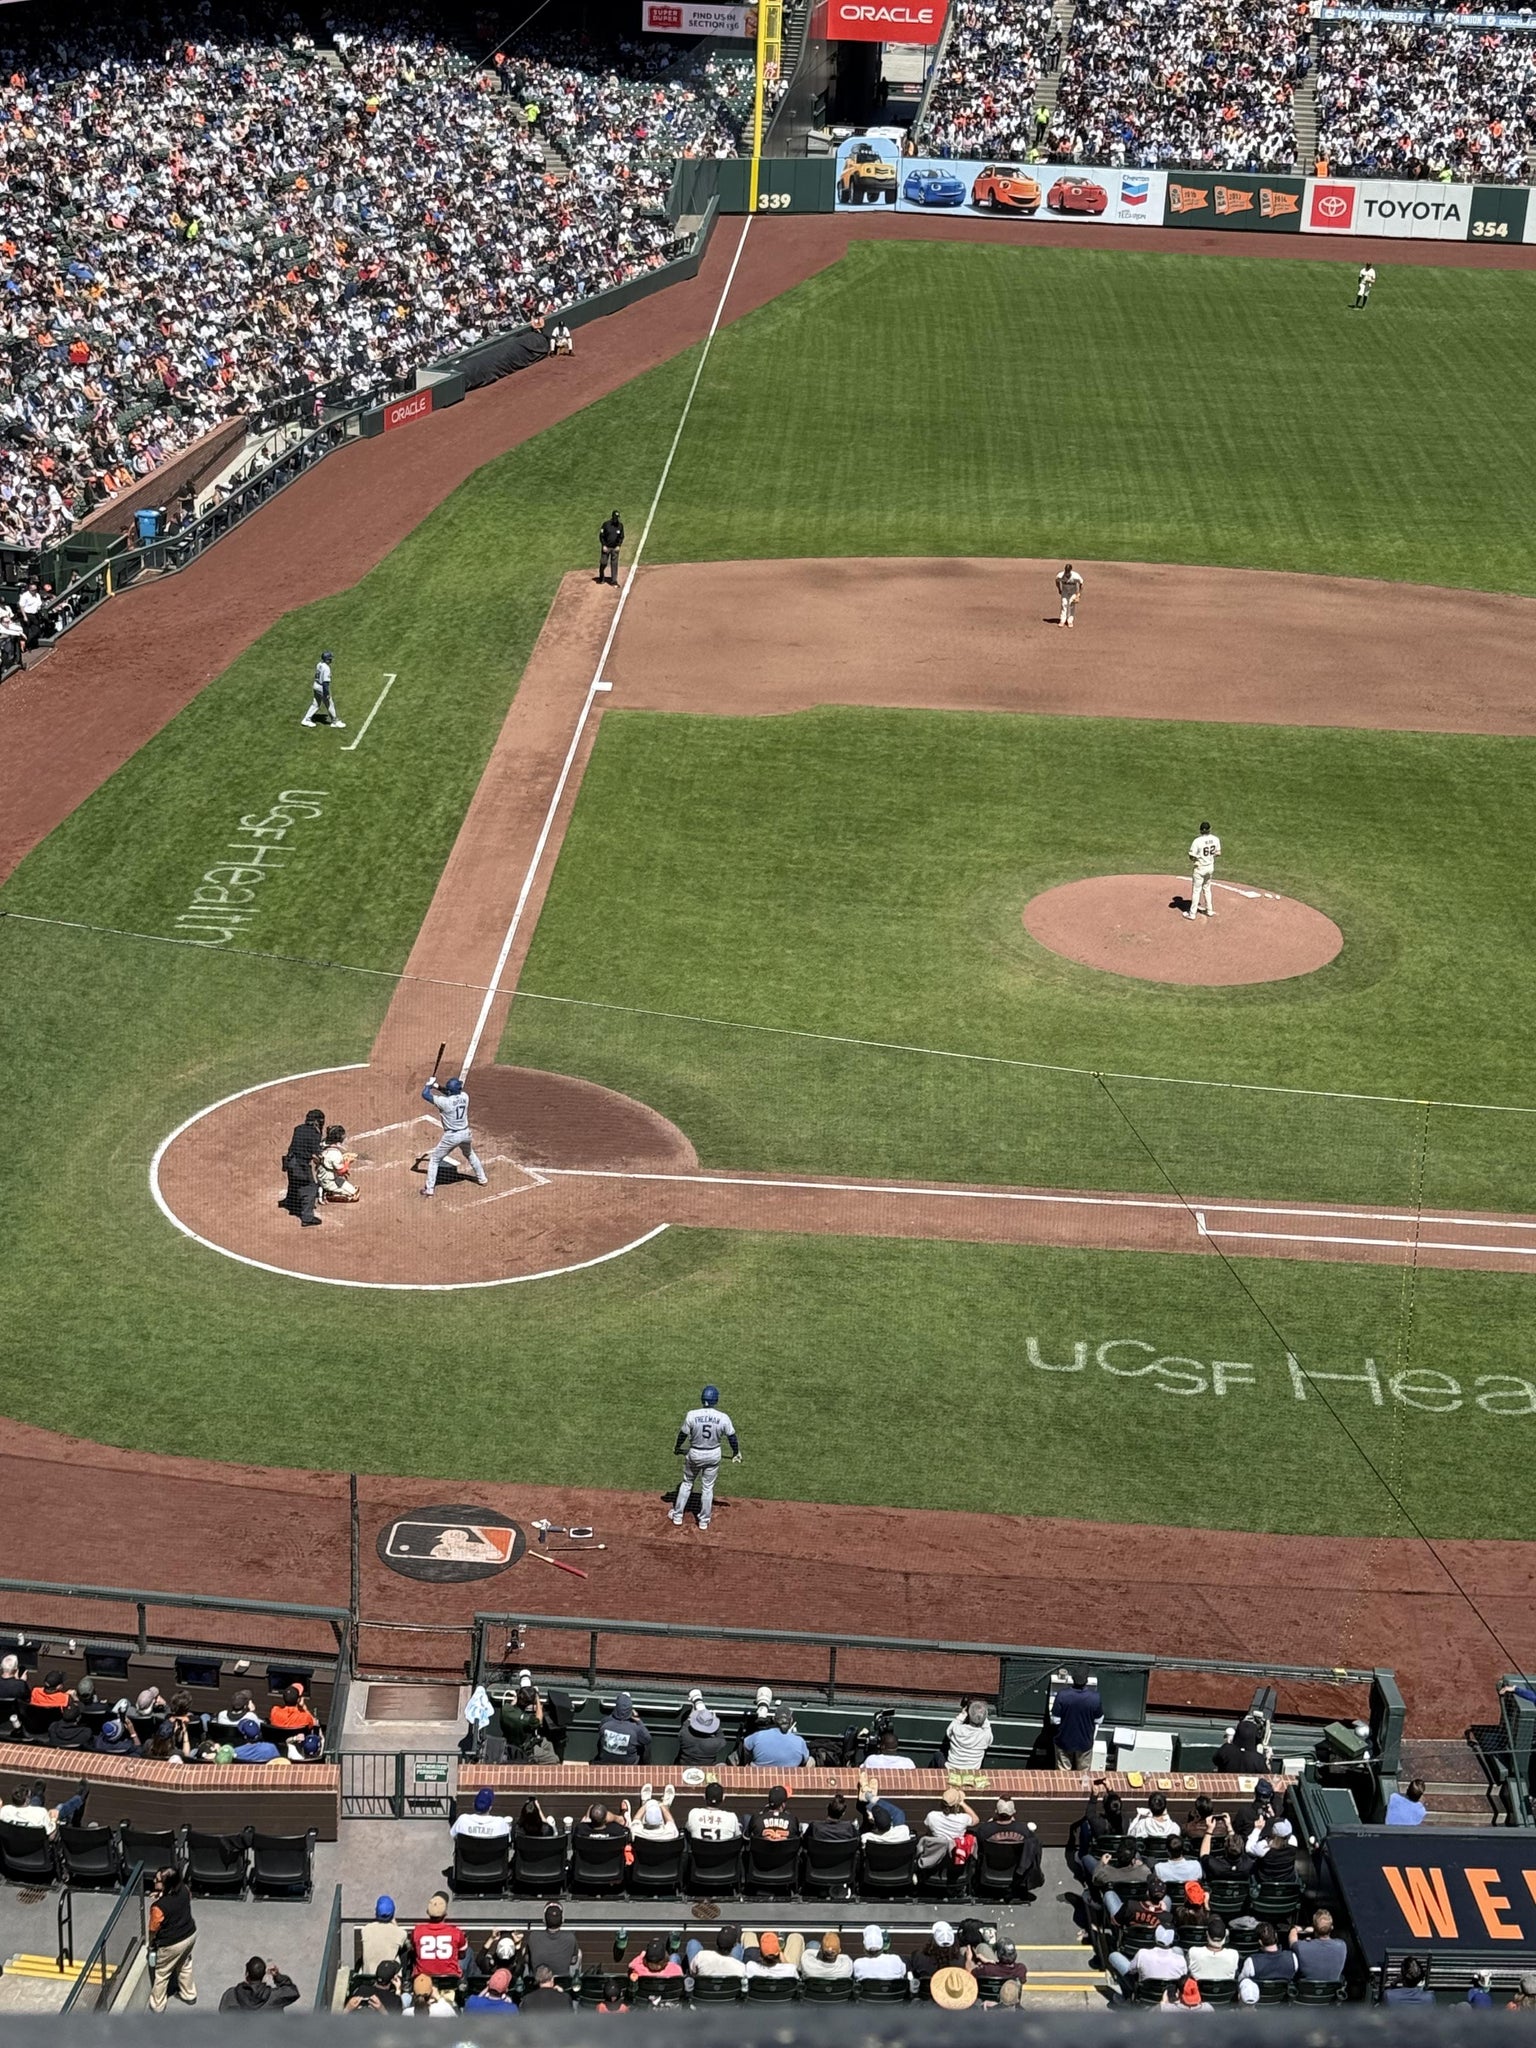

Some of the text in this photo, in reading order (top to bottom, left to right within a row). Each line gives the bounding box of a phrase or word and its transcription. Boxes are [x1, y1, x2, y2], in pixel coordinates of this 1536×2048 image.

[692, 12, 712, 20] FIND
[714, 13, 726, 21] US
[839, 4, 934, 25] ORACLE
[1338, 9, 1359, 19] LOCAL
[1460, 15, 1483, 25] UNION
[688, 20, 725, 29] SECTION
[758, 193, 792, 209] 339
[1363, 199, 1461, 222] TOYOTA
[1471, 221, 1509, 238] 354
[391, 397, 426, 424] ORACLE
[1203, 845, 1216, 857] 62
[174, 789, 330, 945] UCSF Health
[455, 1105, 466, 1120] 17
[1025, 1336, 1257, 1396] UCSF
[694, 1415, 721, 1425] FREEMAN
[702, 1424, 712, 1439] 5
[763, 1818, 790, 1829] BONDS
[700, 1828, 721, 1841] 51
[419, 1935, 453, 1960] 25
